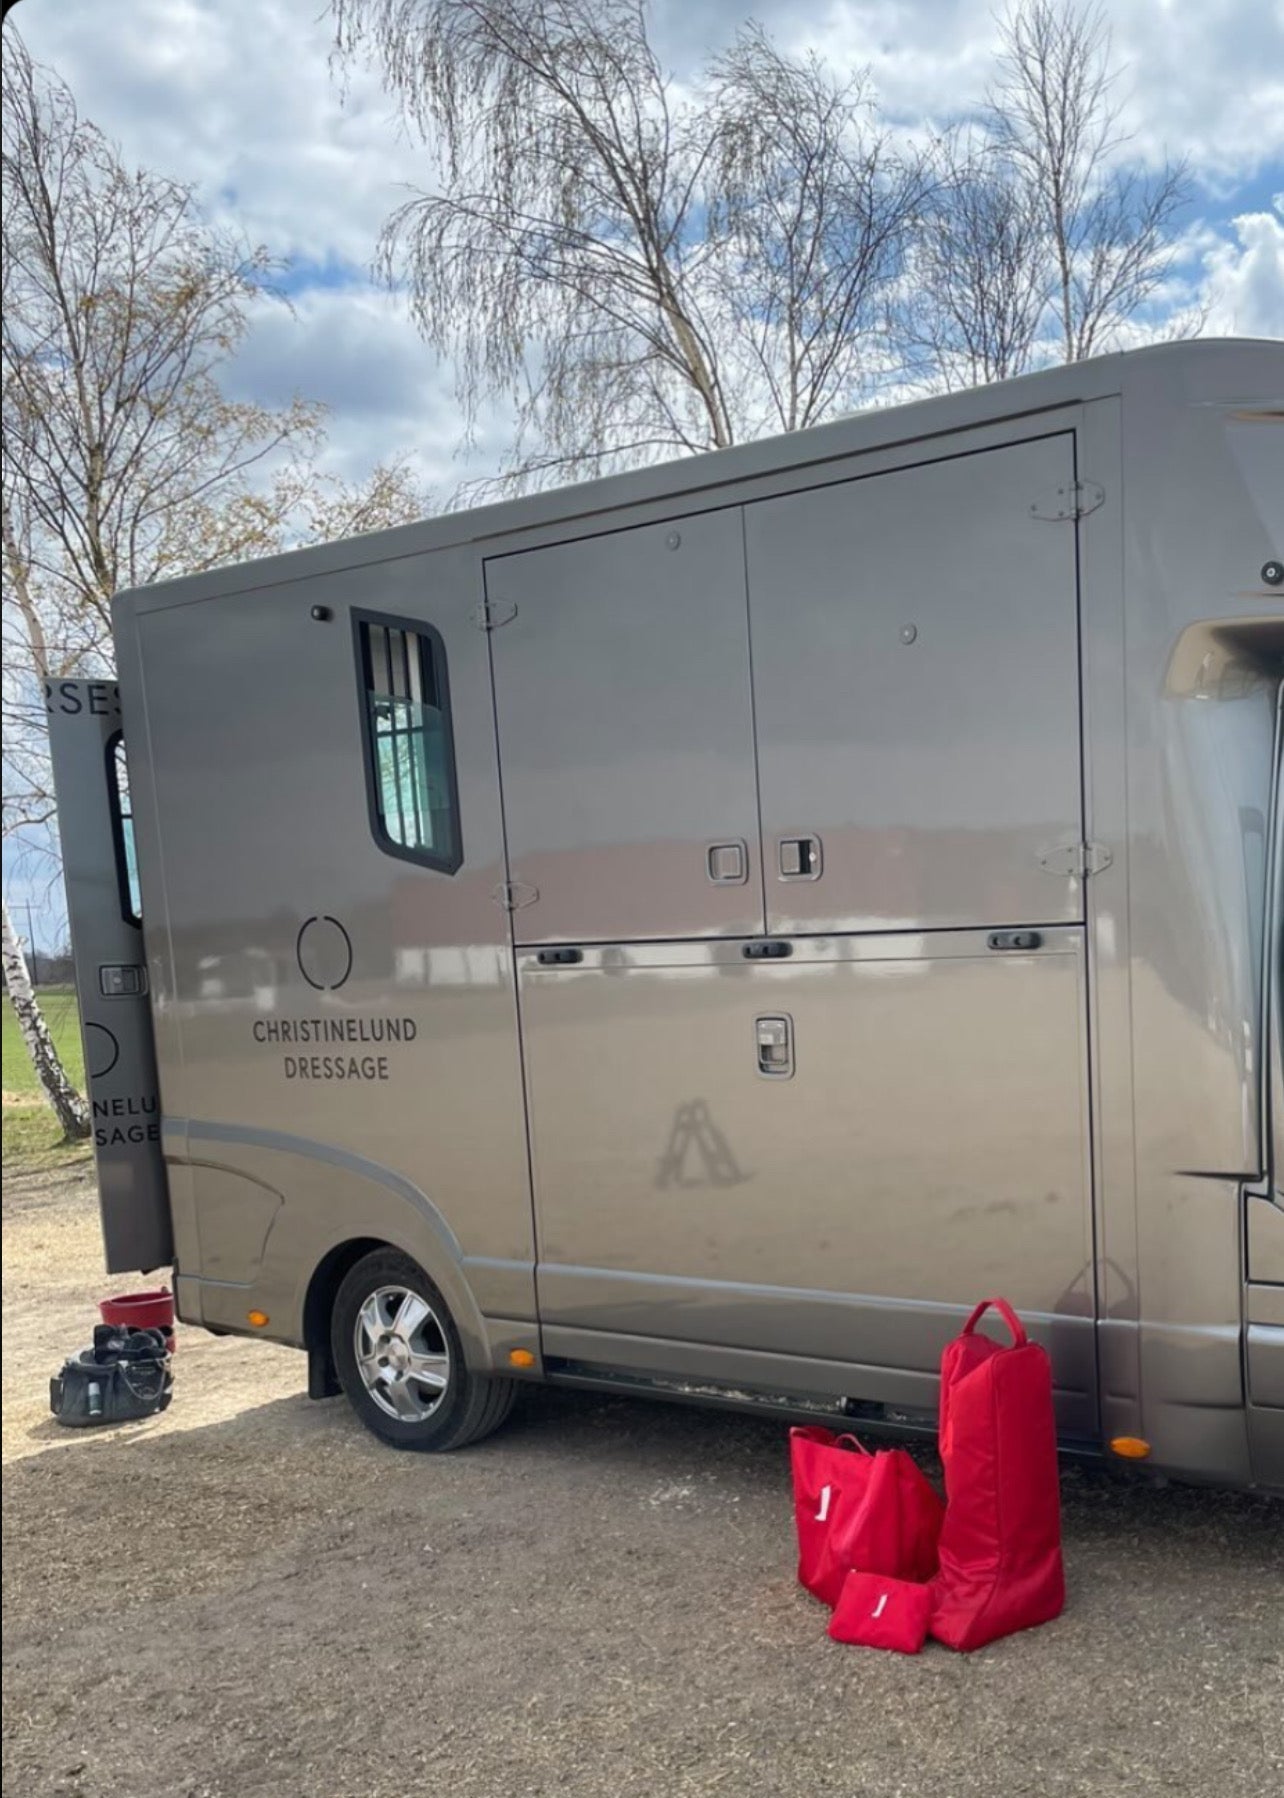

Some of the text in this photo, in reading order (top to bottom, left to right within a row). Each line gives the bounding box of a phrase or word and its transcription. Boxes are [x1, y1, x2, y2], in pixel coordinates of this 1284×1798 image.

[252, 1018, 417, 1042] CHRISTINELUND
[284, 1056, 389, 1080] DRESSAGE
[93, 1096, 156, 1118] NELU
[95, 1124, 160, 1146] SAGE
